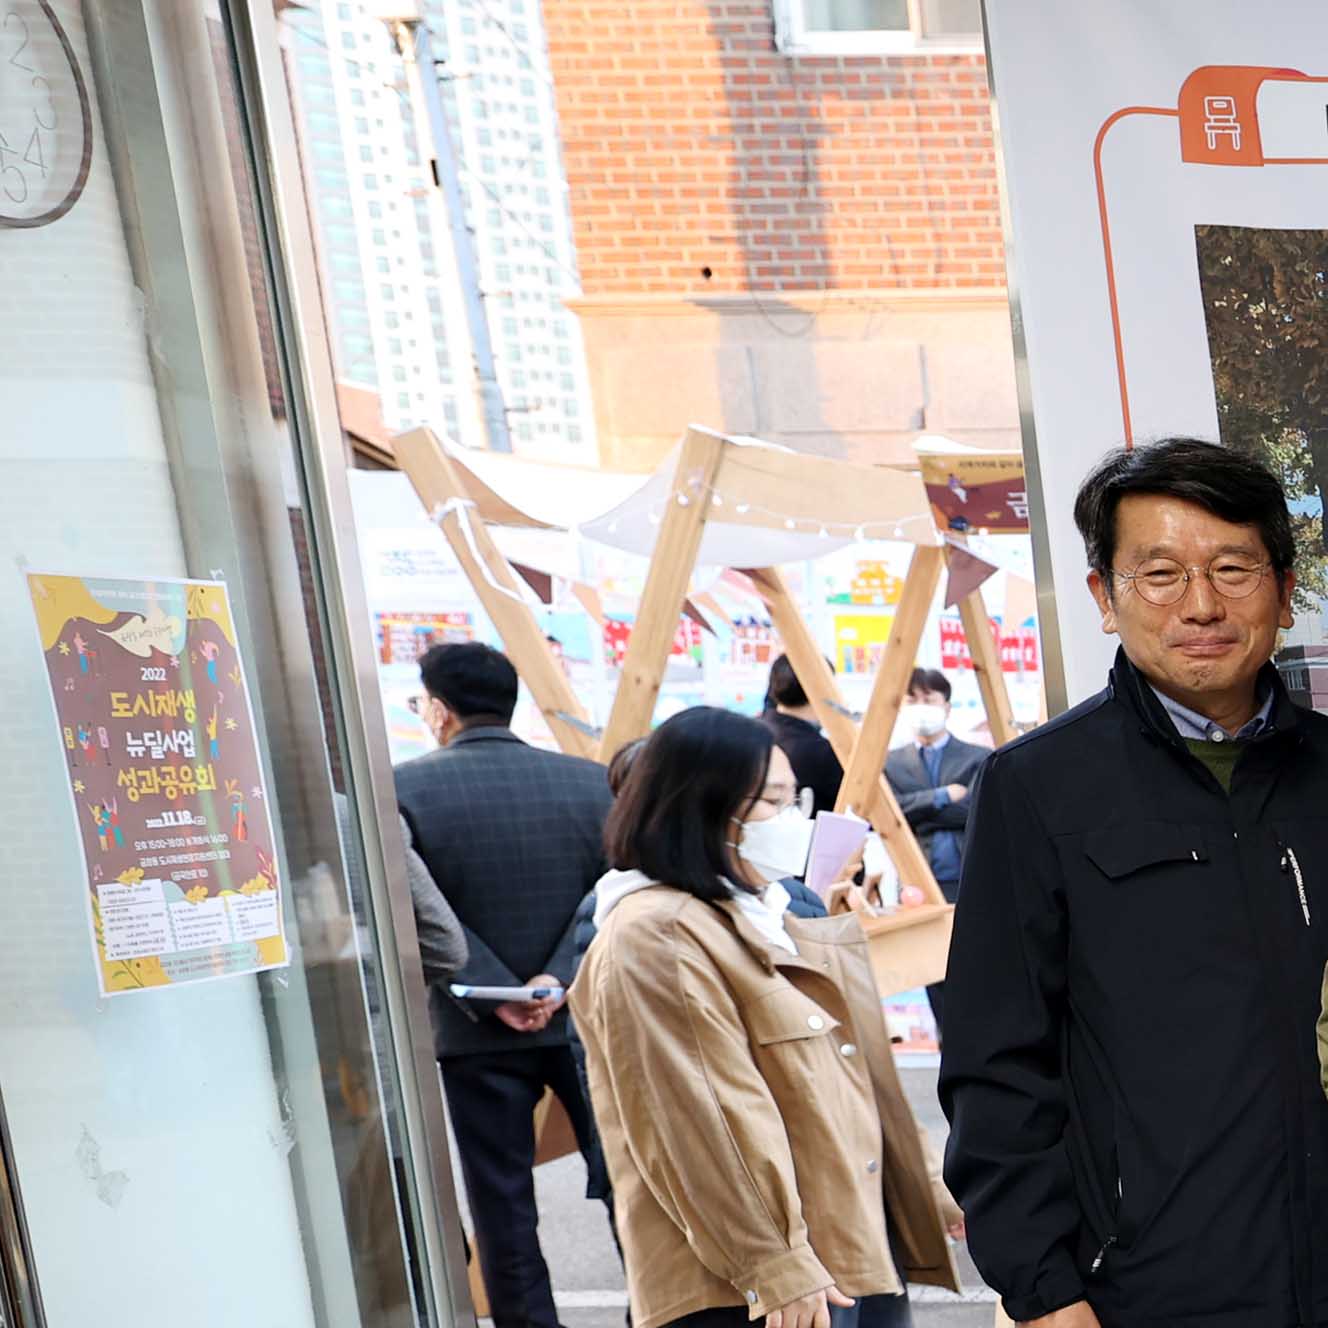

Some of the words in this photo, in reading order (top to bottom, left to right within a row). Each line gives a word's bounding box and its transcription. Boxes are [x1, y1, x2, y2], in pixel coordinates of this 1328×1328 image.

[140, 667, 167, 681] 2022
[110, 689, 197, 725] 도시재생
[126, 729, 196, 760] 뉴딜사업
[116, 763, 217, 803] 성과공유회
